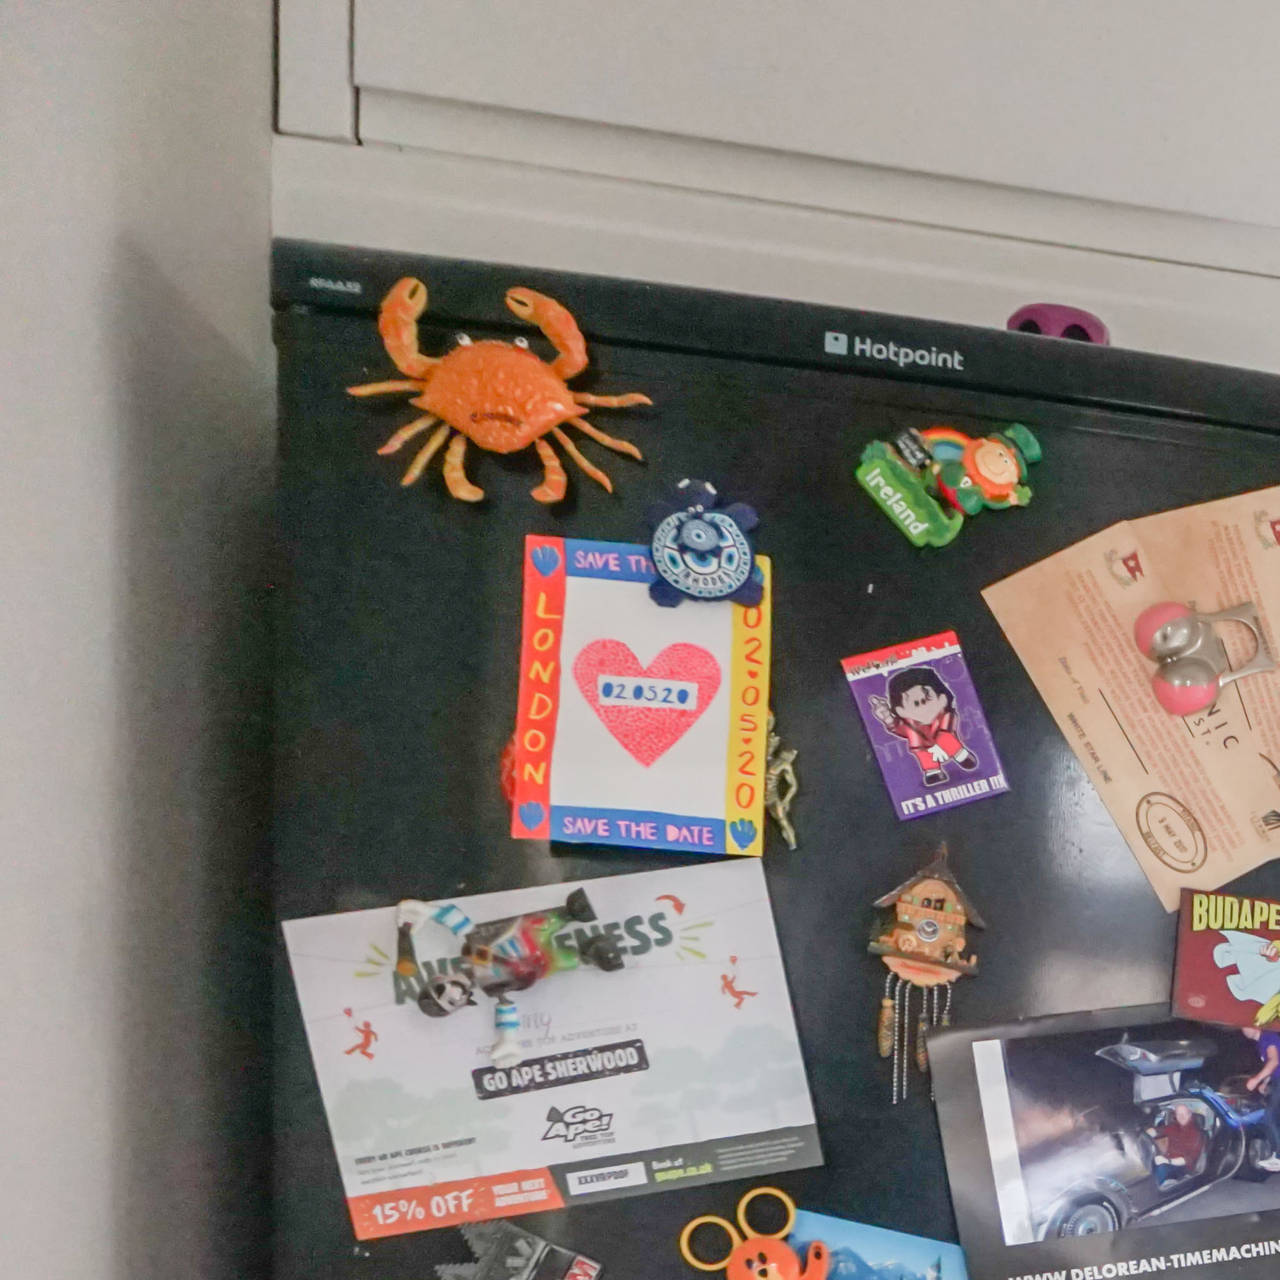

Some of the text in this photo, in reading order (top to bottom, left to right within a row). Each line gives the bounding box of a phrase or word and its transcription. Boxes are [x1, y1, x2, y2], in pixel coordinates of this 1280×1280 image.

[853, 336, 965, 371] Hotpoint
[865, 467, 930, 537] Ireland
[574, 550, 622, 573] SAVE
[522, 591, 562, 785] LONDON
[934, 779, 990, 806] THRILLER
[563, 816, 715, 846] SAVE THE DATE
[483, 1046, 640, 1092] GO APE SHERWOOD
[561, 1105, 602, 1124] Go
[372, 1189, 475, 1225] 15% OFF
